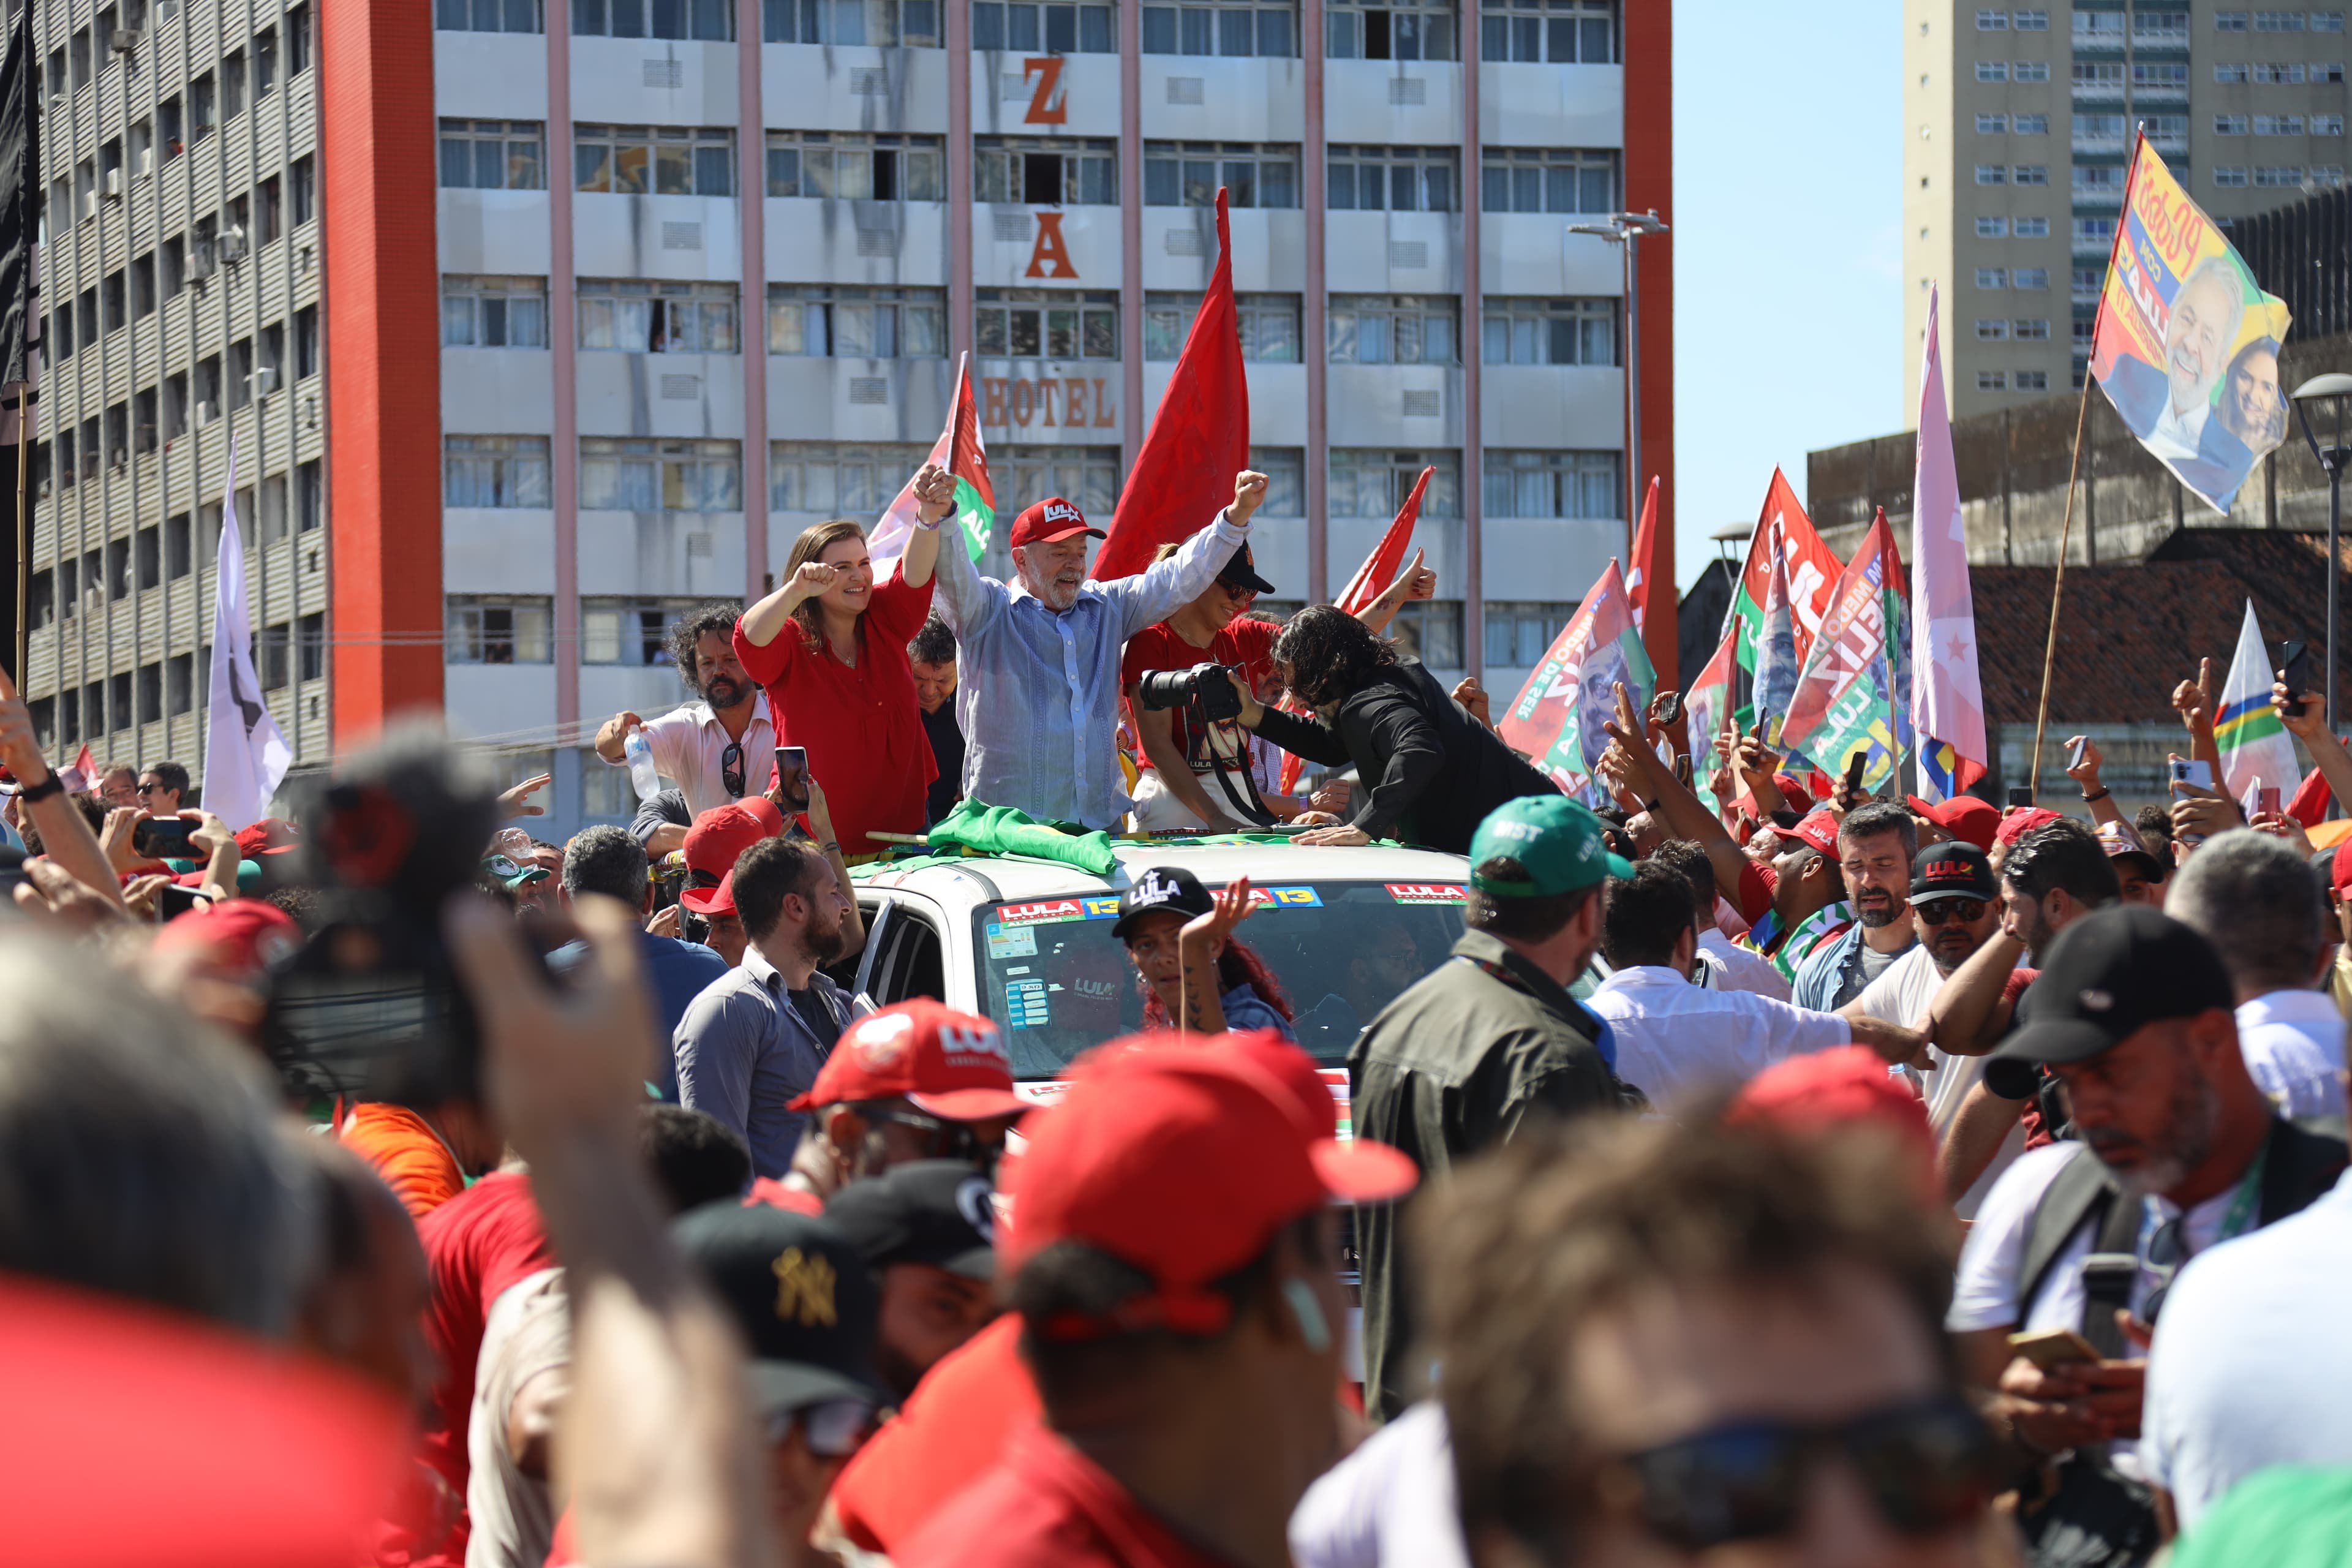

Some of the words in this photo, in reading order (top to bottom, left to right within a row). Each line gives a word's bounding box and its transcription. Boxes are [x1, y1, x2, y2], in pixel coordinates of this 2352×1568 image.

[982, 377, 1115, 428] HOTEL
[1044, 504, 1081, 523] LULA
[1493, 820, 1545, 843] MST
[1809, 824, 1833, 846] LULA
[1926, 860, 1973, 877] LULA
[1129, 880, 1182, 907] LULA
[1275, 890, 1314, 903] 13
[1391, 886, 1464, 897] LULA
[1002, 902, 1079, 918] LULA
[1086, 899, 1120, 915] 13
[1006, 911, 1079, 921] PRESIDENTE
[1008, 917, 1063, 927] ALCKMIN
[1074, 978, 1113, 995] LULA
